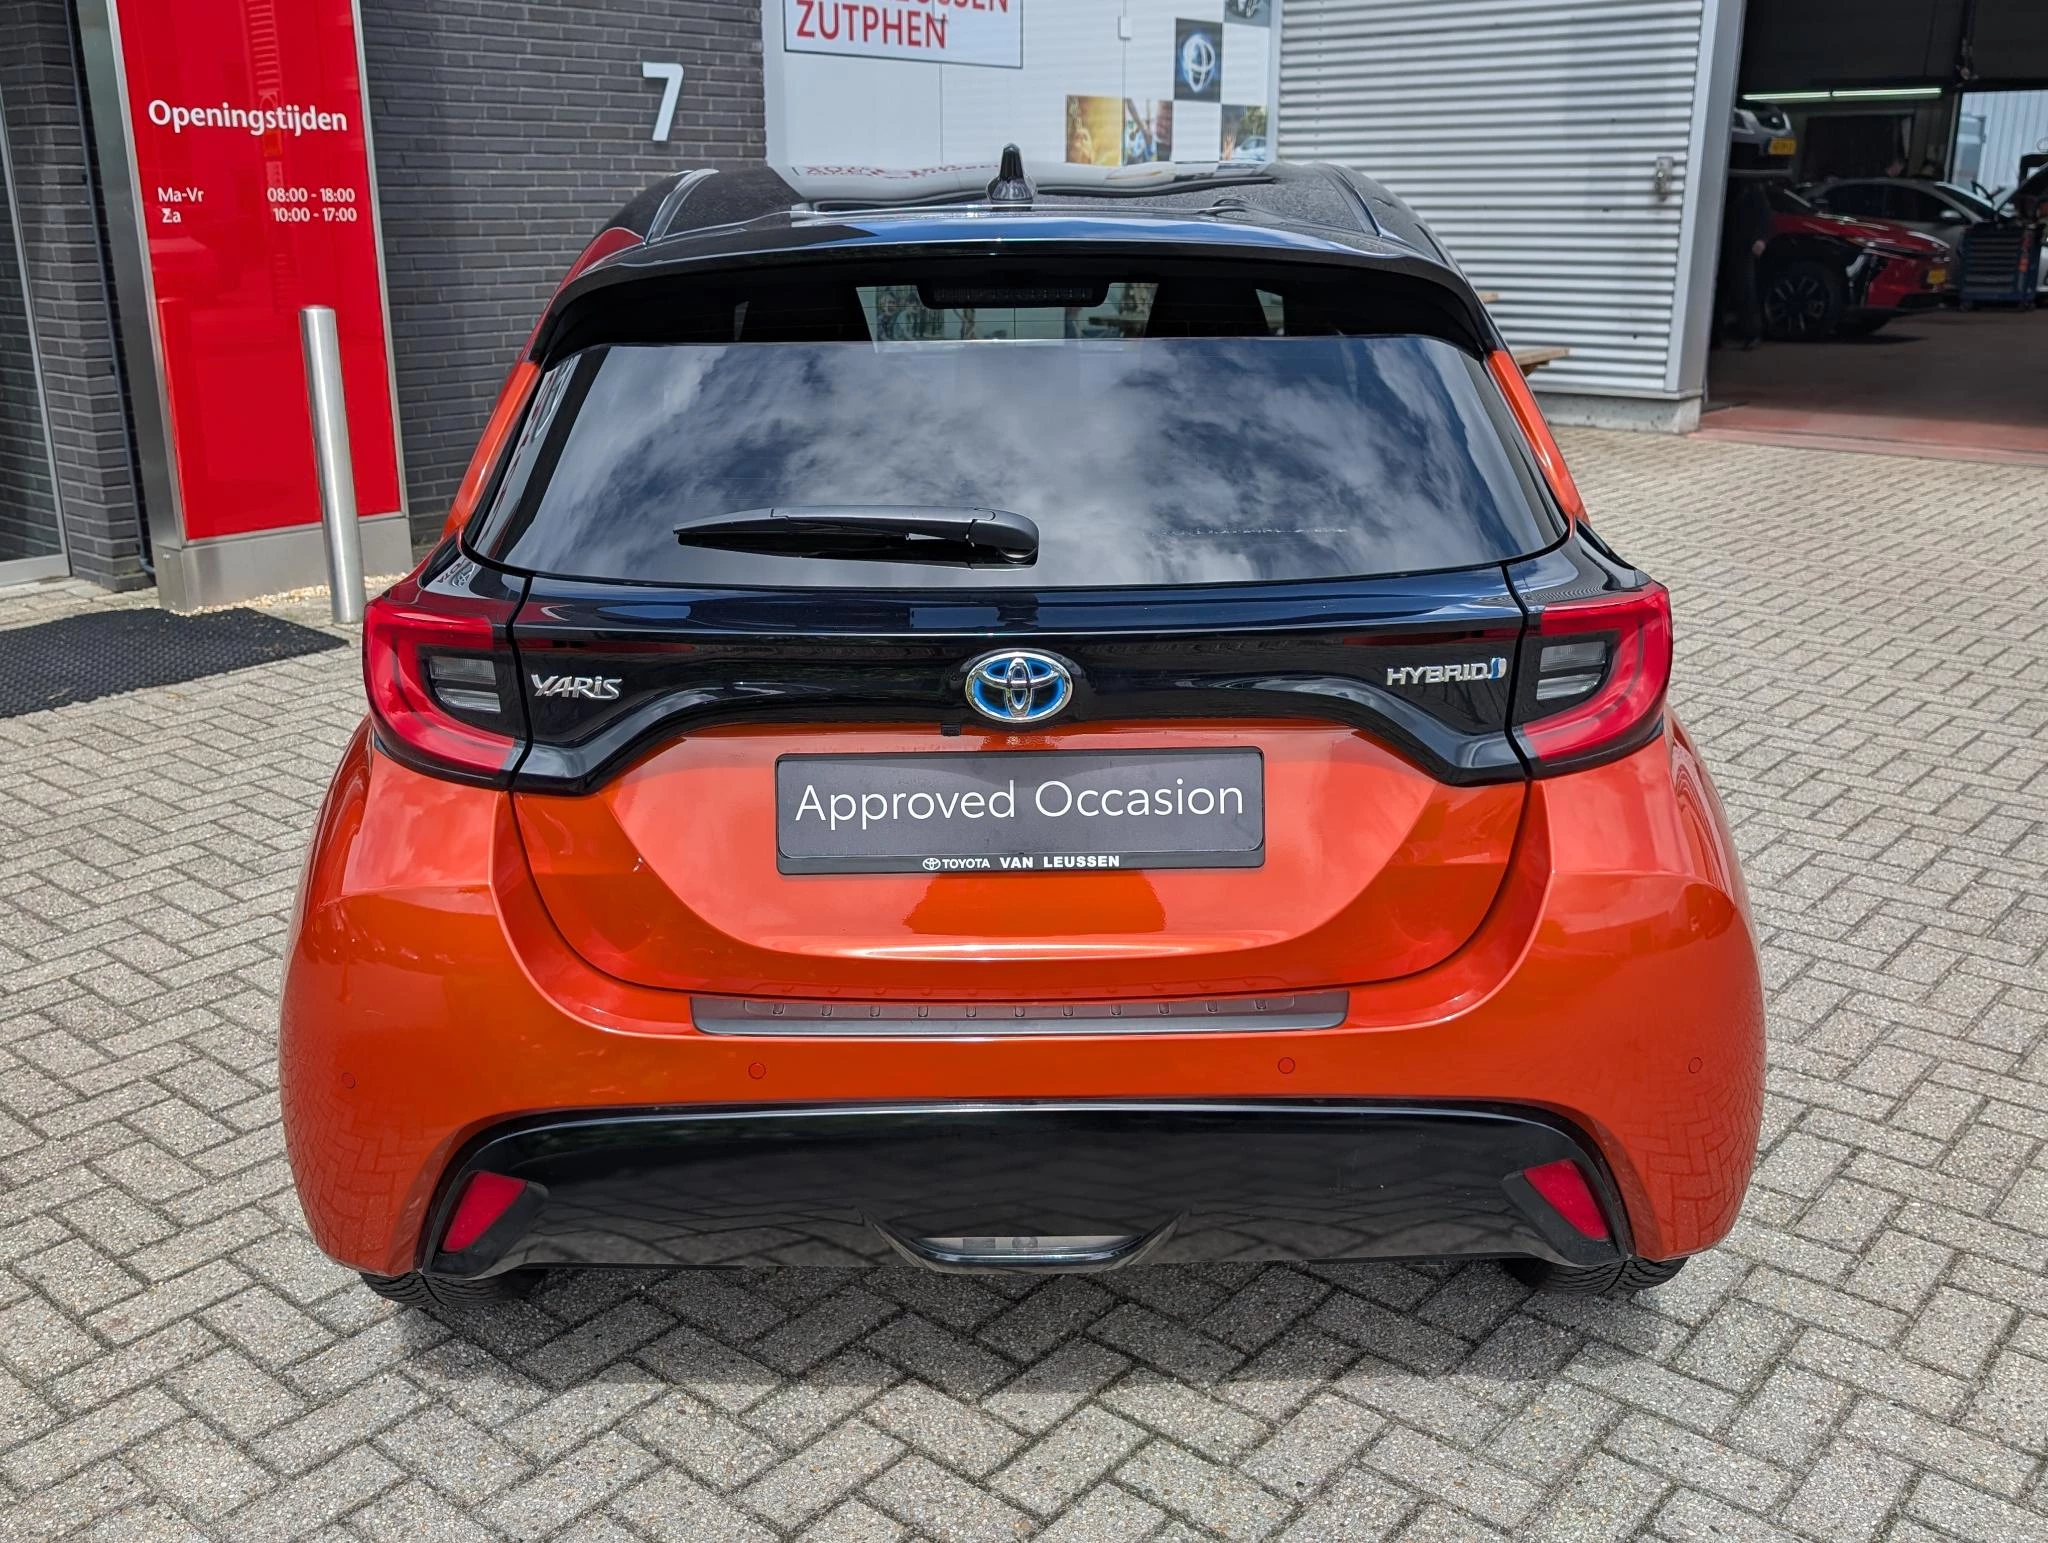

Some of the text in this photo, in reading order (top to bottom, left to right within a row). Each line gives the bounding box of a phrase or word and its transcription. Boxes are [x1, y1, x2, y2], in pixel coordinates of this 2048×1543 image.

[796, 0, 947, 49] ZUTPHEN
[642, 62, 684, 141] 7
[148, 99, 348, 136] Openingstijden
[157, 186, 204, 203] Ma-Vr
[267, 187, 308, 203] 08:00
[320, 187, 356, 203] 18:00
[161, 207, 182, 224] Za
[273, 207, 311, 223] 10:00
[322, 207, 358, 223] 17:00
[1386, 662, 1488, 686] HYBRID
[795, 778, 1243, 831] Approved Occasion
[941, 855, 1120, 869] TOYOTA VAN LEUSSEN
